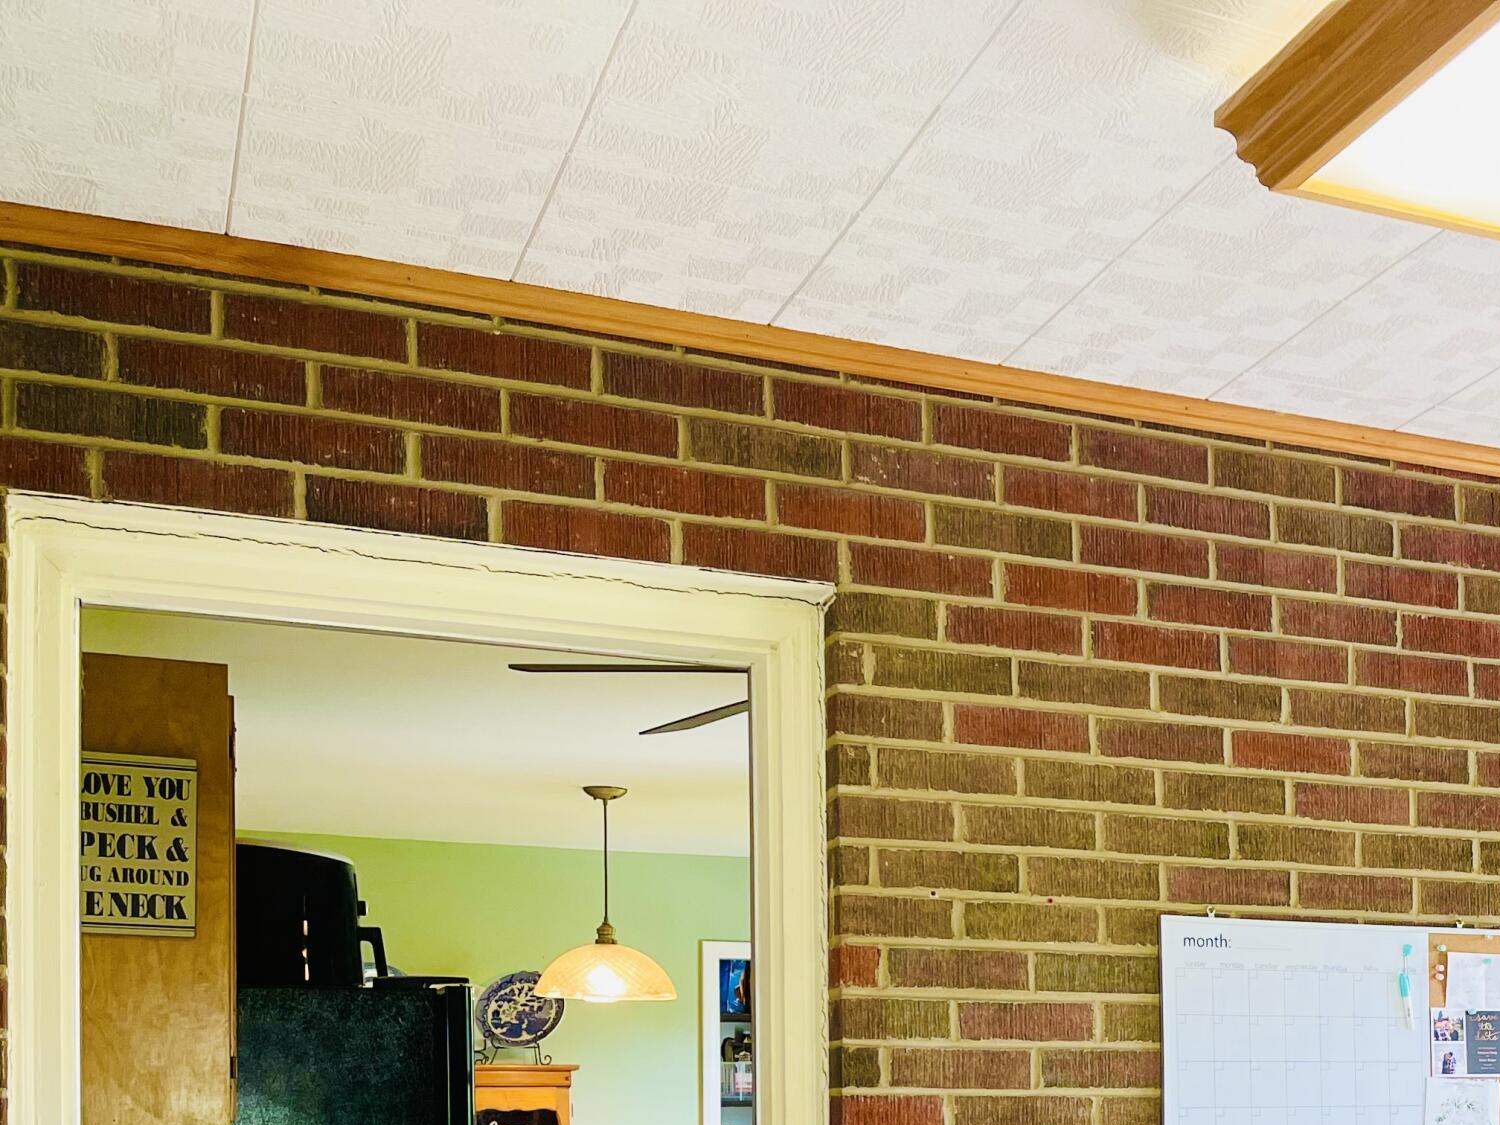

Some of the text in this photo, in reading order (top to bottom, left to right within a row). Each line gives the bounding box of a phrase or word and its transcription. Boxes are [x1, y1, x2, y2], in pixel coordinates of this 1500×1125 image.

[81, 772, 191, 800] OVE YOU
[81, 801, 188, 827] BUSHEL &
[81, 831, 189, 862] PECK &
[81, 865, 190, 886] UG AROUND
[108, 892, 188, 920] NECK
[1183, 933, 1232, 949] month:
